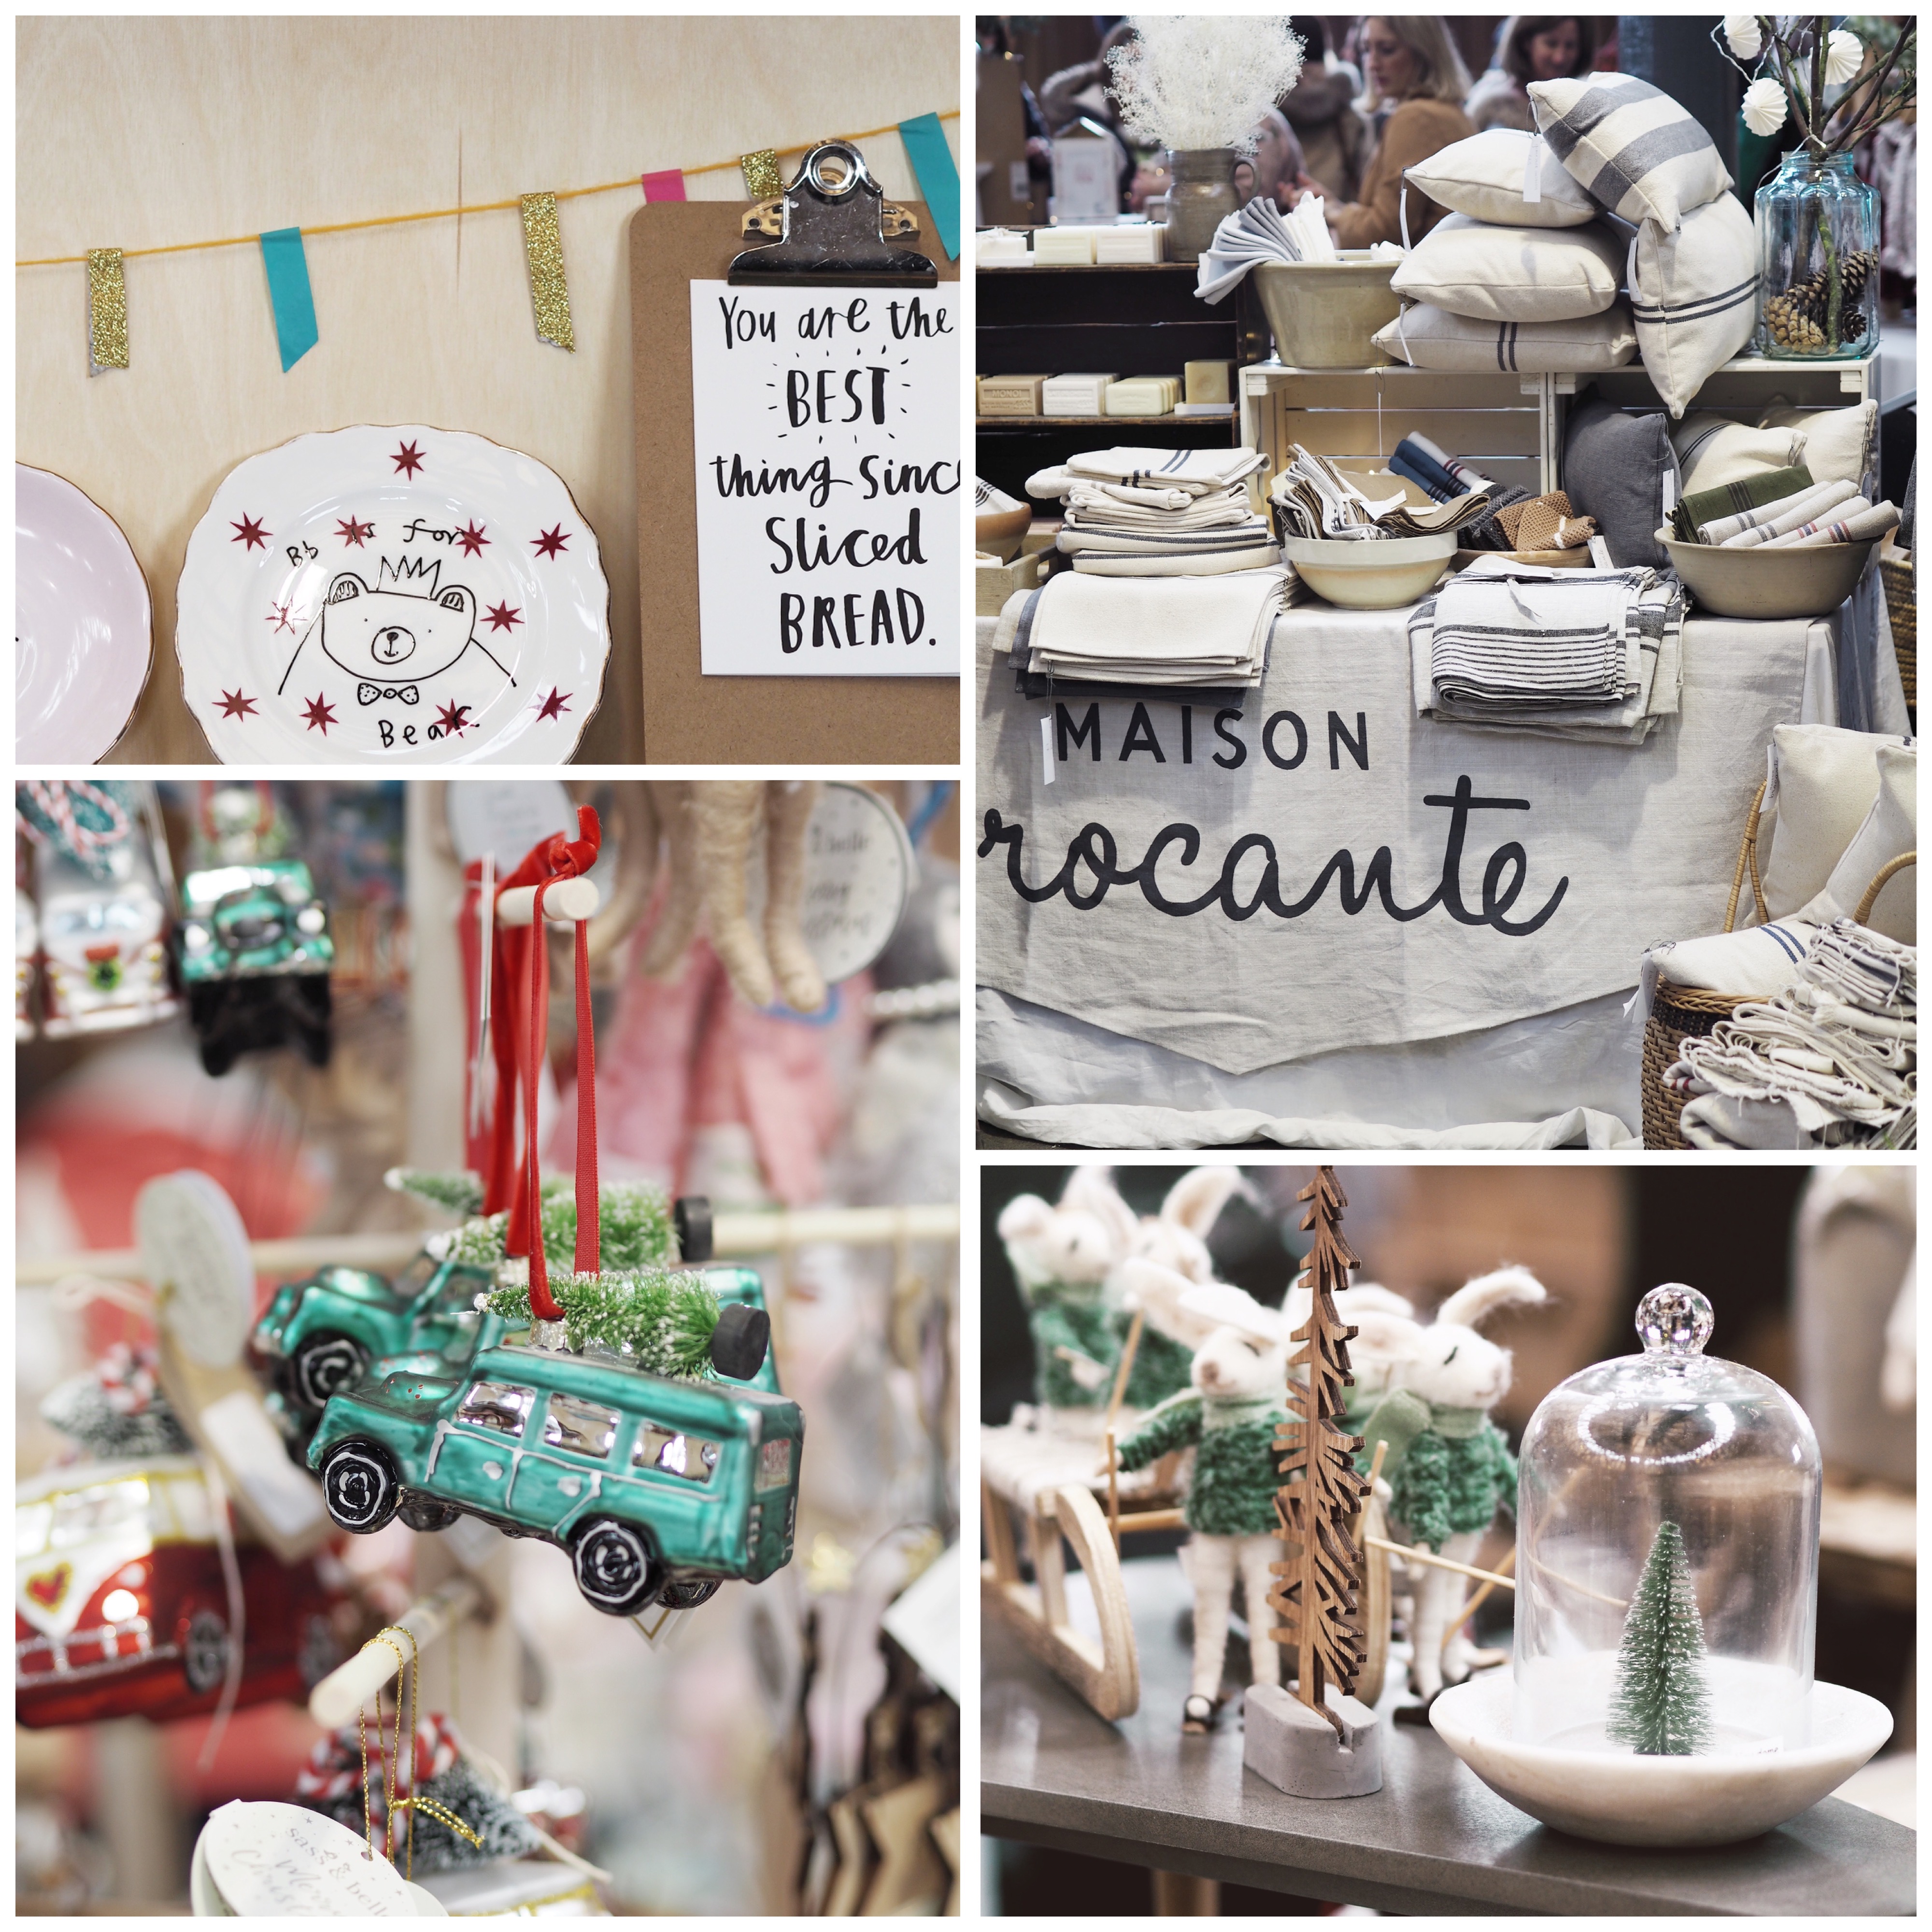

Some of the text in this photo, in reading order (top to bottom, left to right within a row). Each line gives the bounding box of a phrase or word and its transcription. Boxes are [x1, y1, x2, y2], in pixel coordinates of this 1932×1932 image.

[719, 296, 954, 349] You are the
[787, 366, 890, 427] BEST
[709, 453, 853, 508] thing
[403, 518, 468, 545] for
[780, 587, 937, 653] BREAD.
[1056, 702, 1369, 771] MAISON
[346, 1881, 388, 1917] bell
